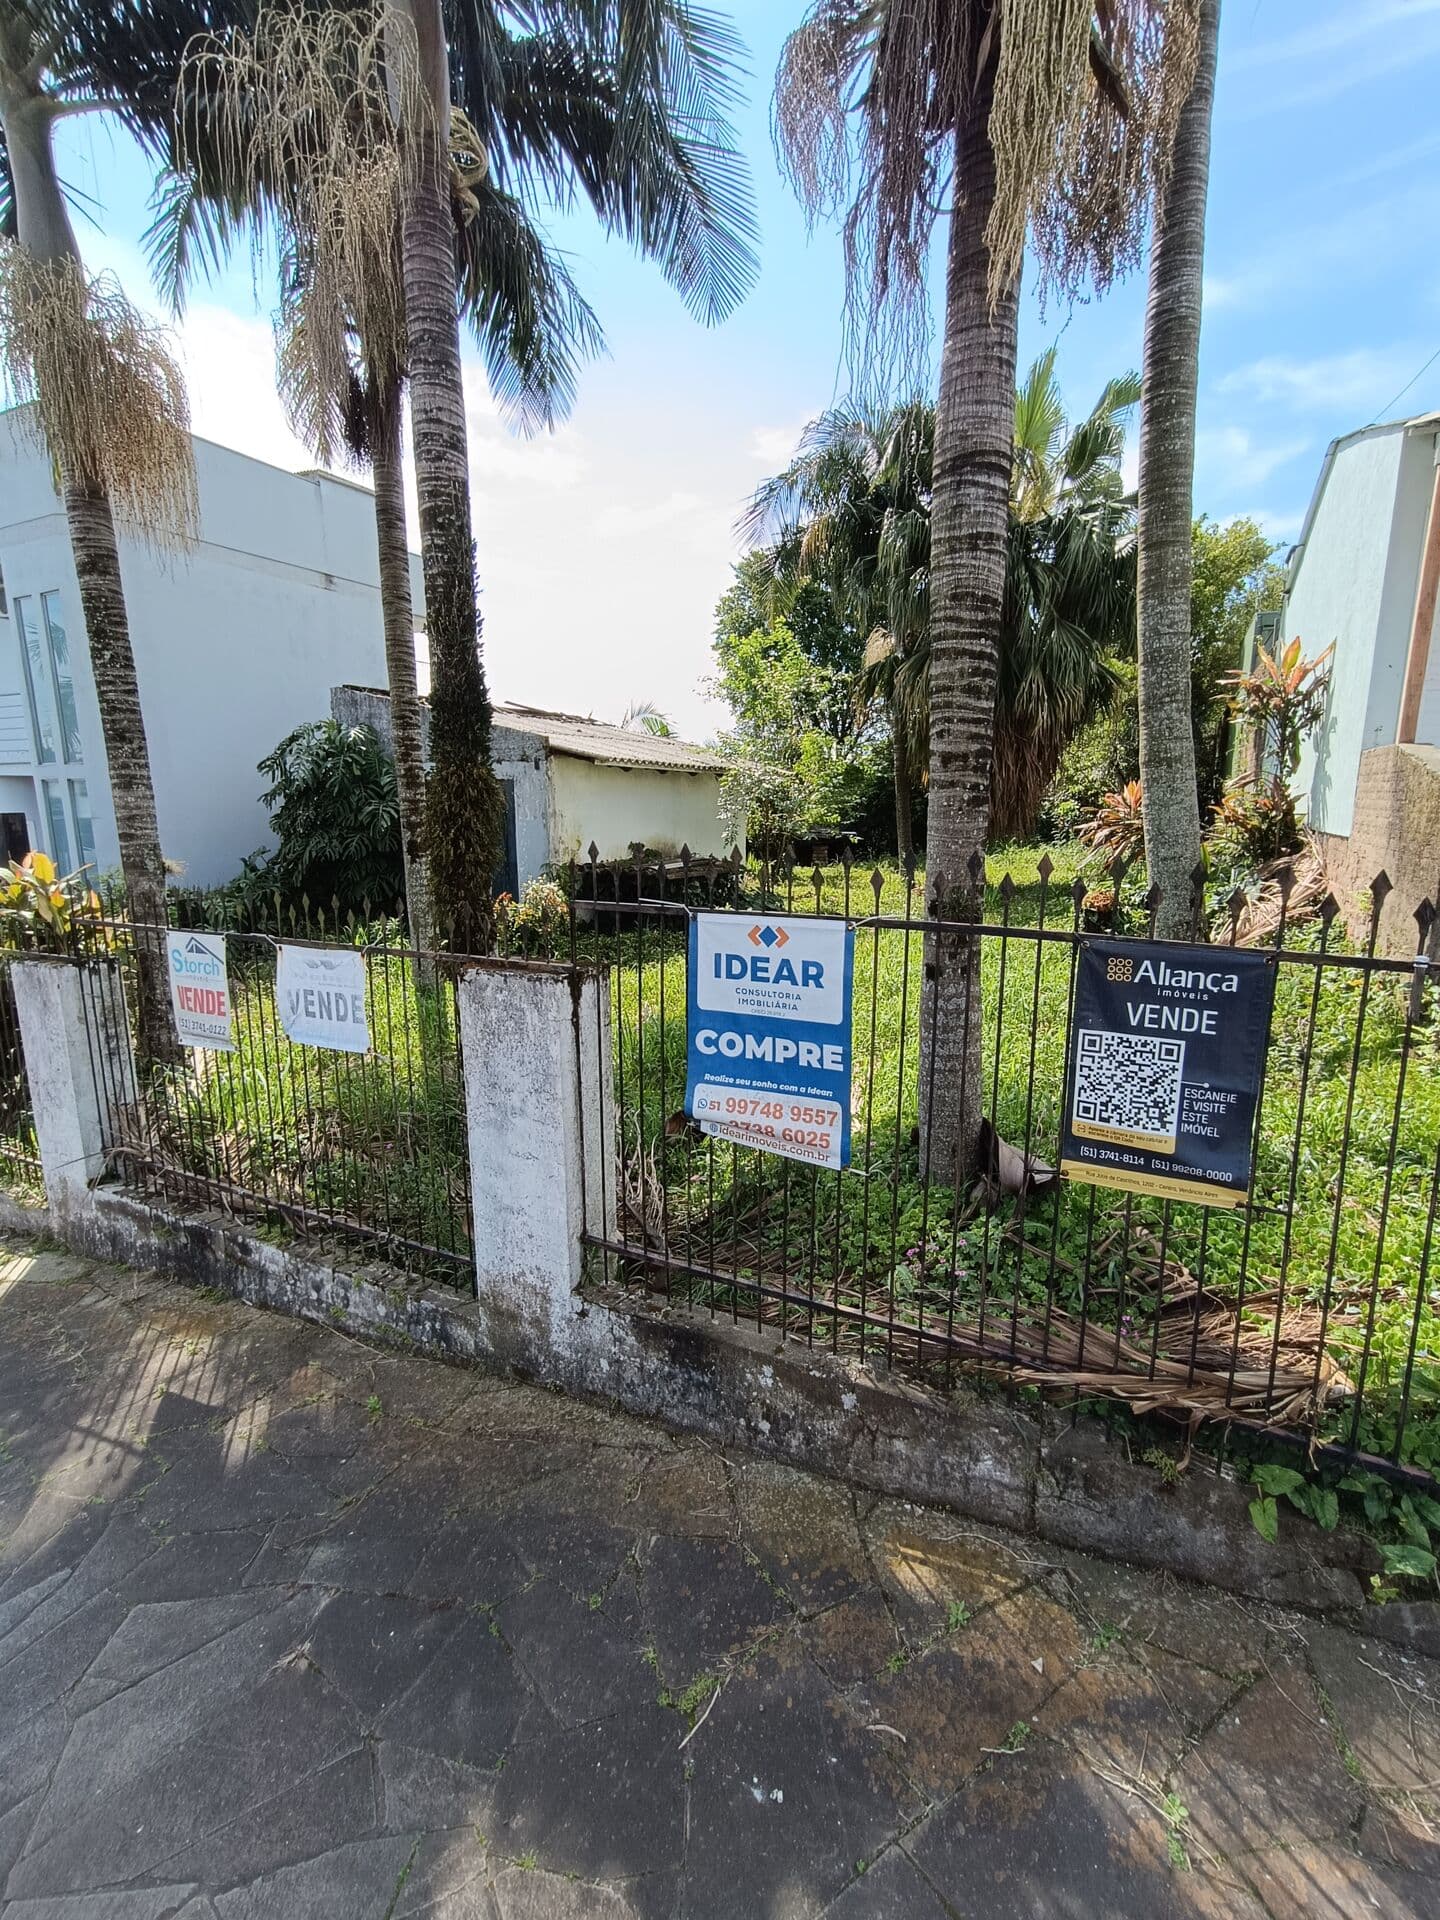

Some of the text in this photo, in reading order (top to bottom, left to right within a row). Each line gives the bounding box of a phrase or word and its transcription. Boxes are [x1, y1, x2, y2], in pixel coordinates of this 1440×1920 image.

[171, 949, 220, 976] Storch
[714, 953, 824, 989] IDEAR
[1134, 960, 1239, 993] Aliança
[177, 985, 226, 1017] VENDE
[288, 988, 365, 1025] VENDE
[735, 987, 802, 1001] CONSULTORIA
[738, 998, 799, 1011] IMOBILIÁRIA
[1157, 988, 1209, 1001] imóveis
[1127, 1002, 1219, 1035] VENDE
[695, 1029, 844, 1072] COMPRE
[704, 1073, 734, 1084] Realize
[735, 1078, 751, 1086] seu
[752, 1079, 778, 1089] sonho
[779, 1083, 798, 1092] com
[1184, 1088, 1238, 1104] ESCANEIE
[709, 1097, 838, 1127] 51 99748 9557
[1182, 1112, 1209, 1124] ESTE
[1183, 1101, 1226, 1114] E VISITE
[719, 1124, 832, 1162] idearimoveis.com.br
[782, 1127, 831, 1149] 6025
[1180, 1121, 1220, 1138] IMÓVEL
[1080, 1145, 1233, 1182] (51) 3741-8114 (51) 99208-0000
